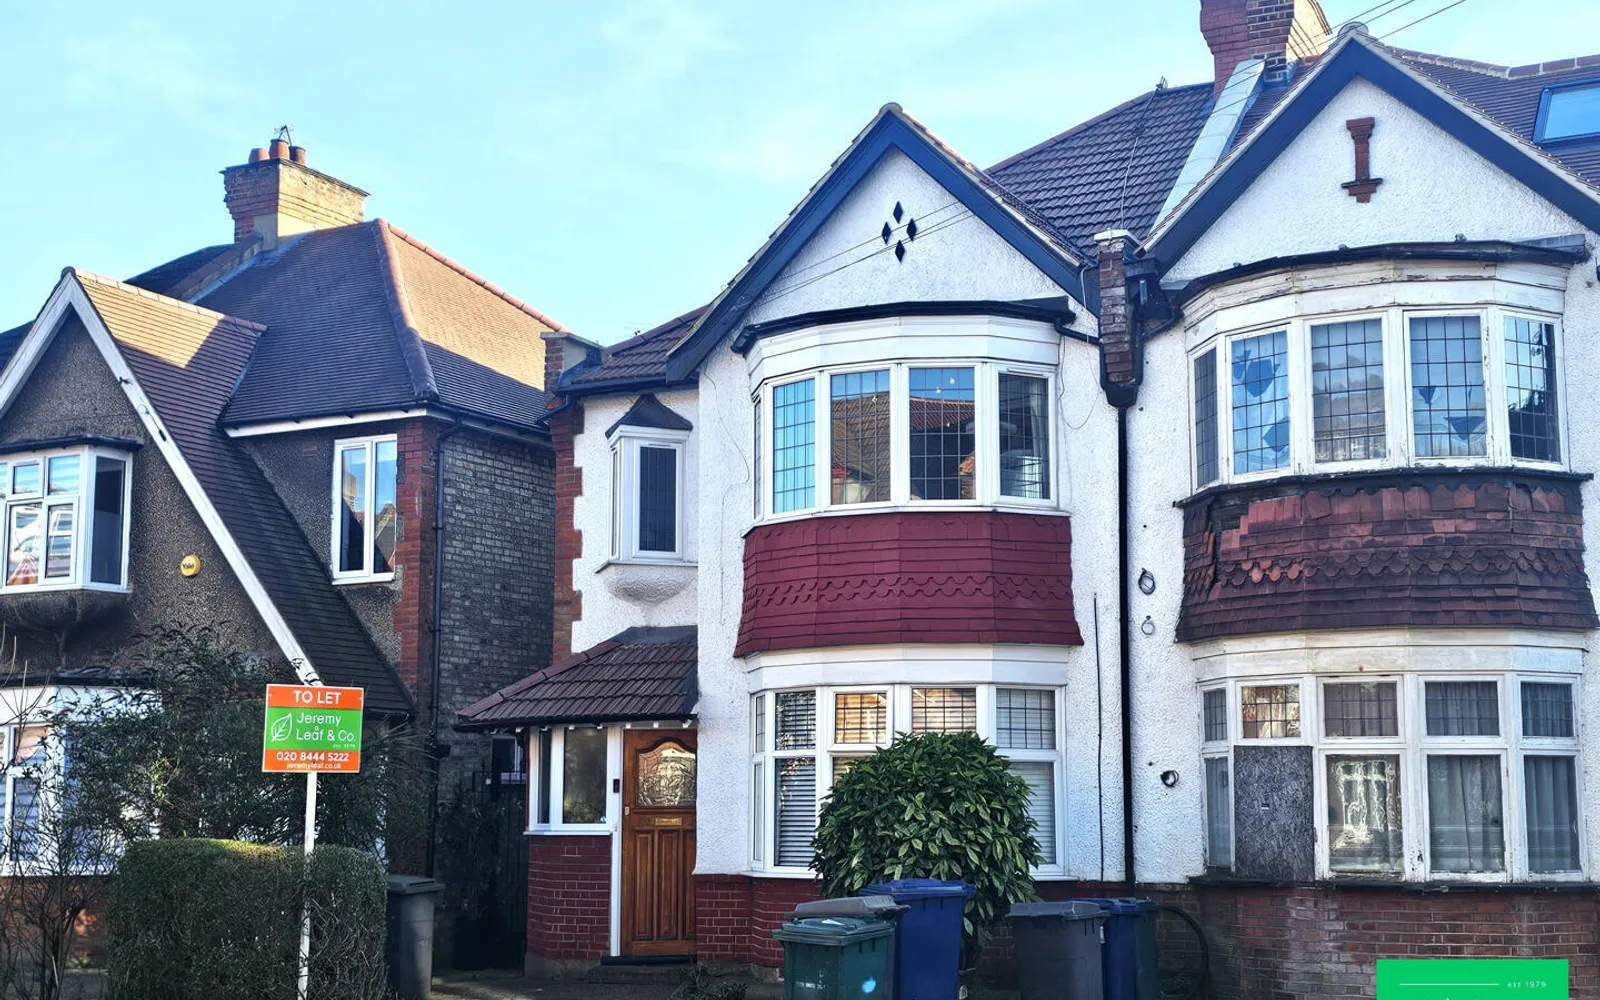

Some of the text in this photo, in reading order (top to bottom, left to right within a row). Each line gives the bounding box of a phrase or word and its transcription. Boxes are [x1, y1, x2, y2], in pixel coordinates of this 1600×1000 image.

[294, 690, 342, 704] TO LET
[296, 712, 342, 726] Jeremy
[296, 729, 356, 742] Leaf & Co.
[276, 751, 349, 762] 020 8444 5222
